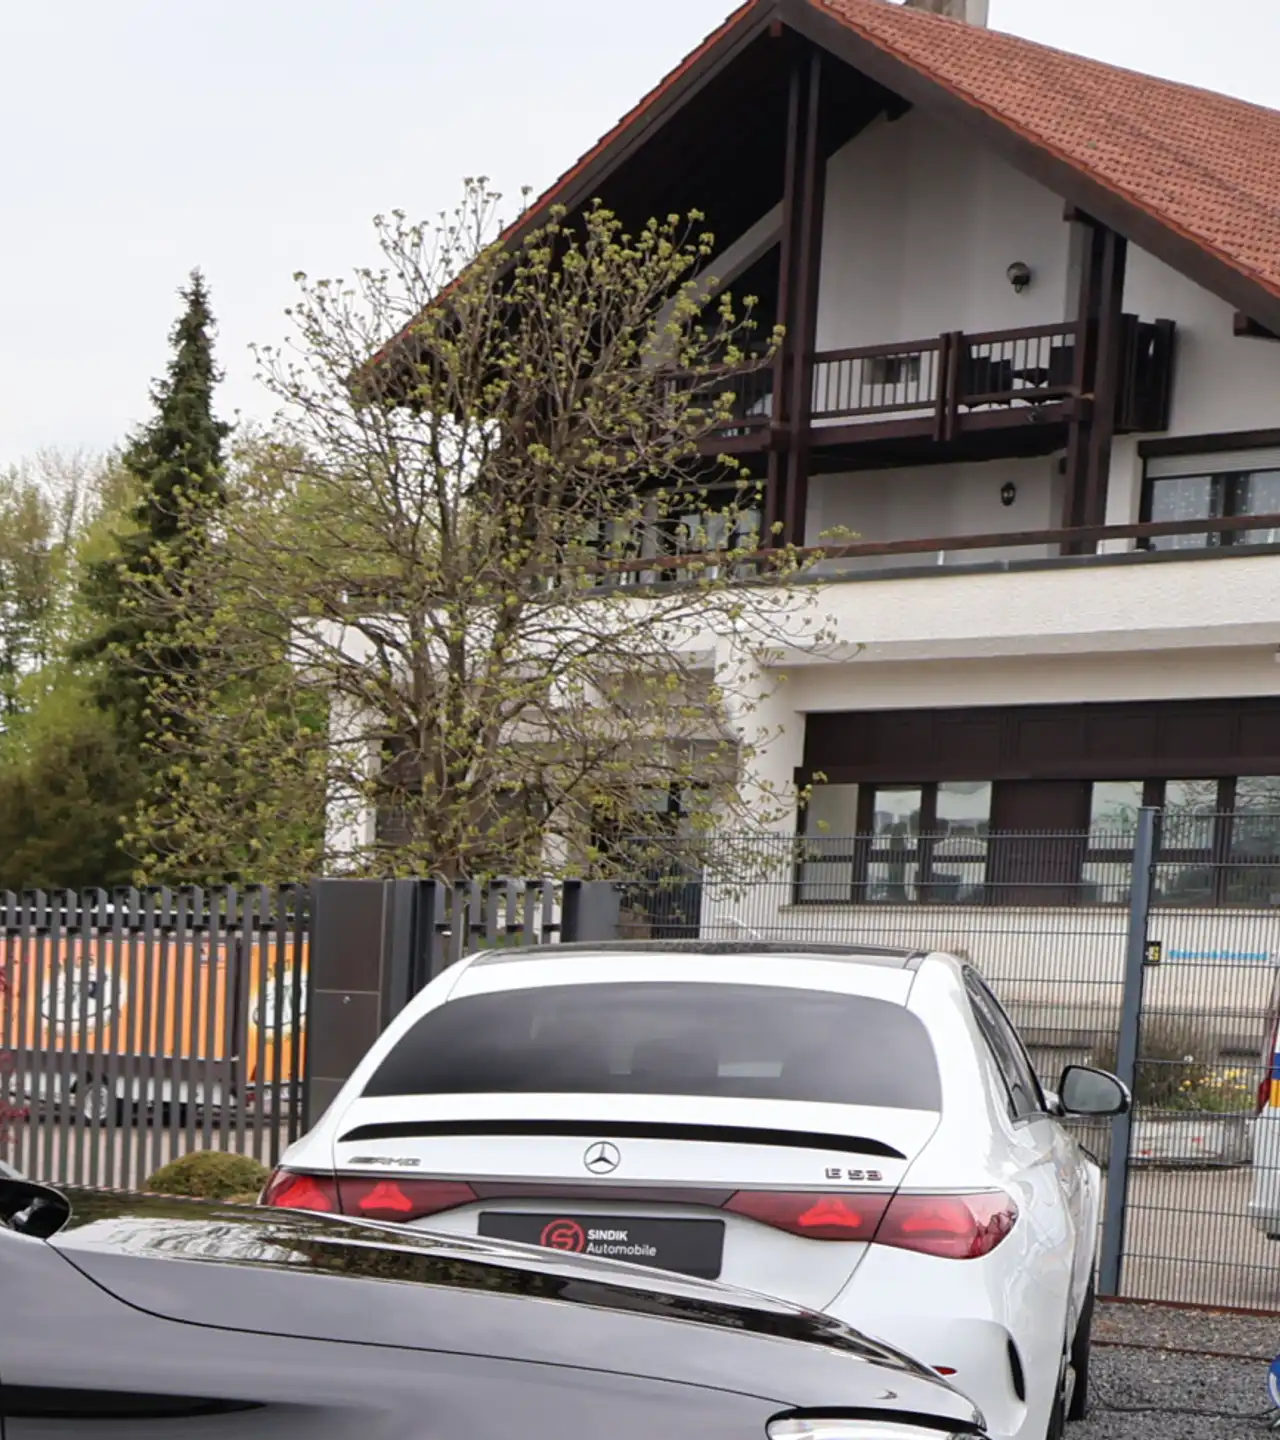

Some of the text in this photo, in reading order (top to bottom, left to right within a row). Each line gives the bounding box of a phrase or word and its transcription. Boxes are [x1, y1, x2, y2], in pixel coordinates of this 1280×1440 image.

[824, 1168, 883, 1181] E 53
[587, 1229, 628, 1242] SINDIK
[586, 1242, 657, 1257] Automobile
